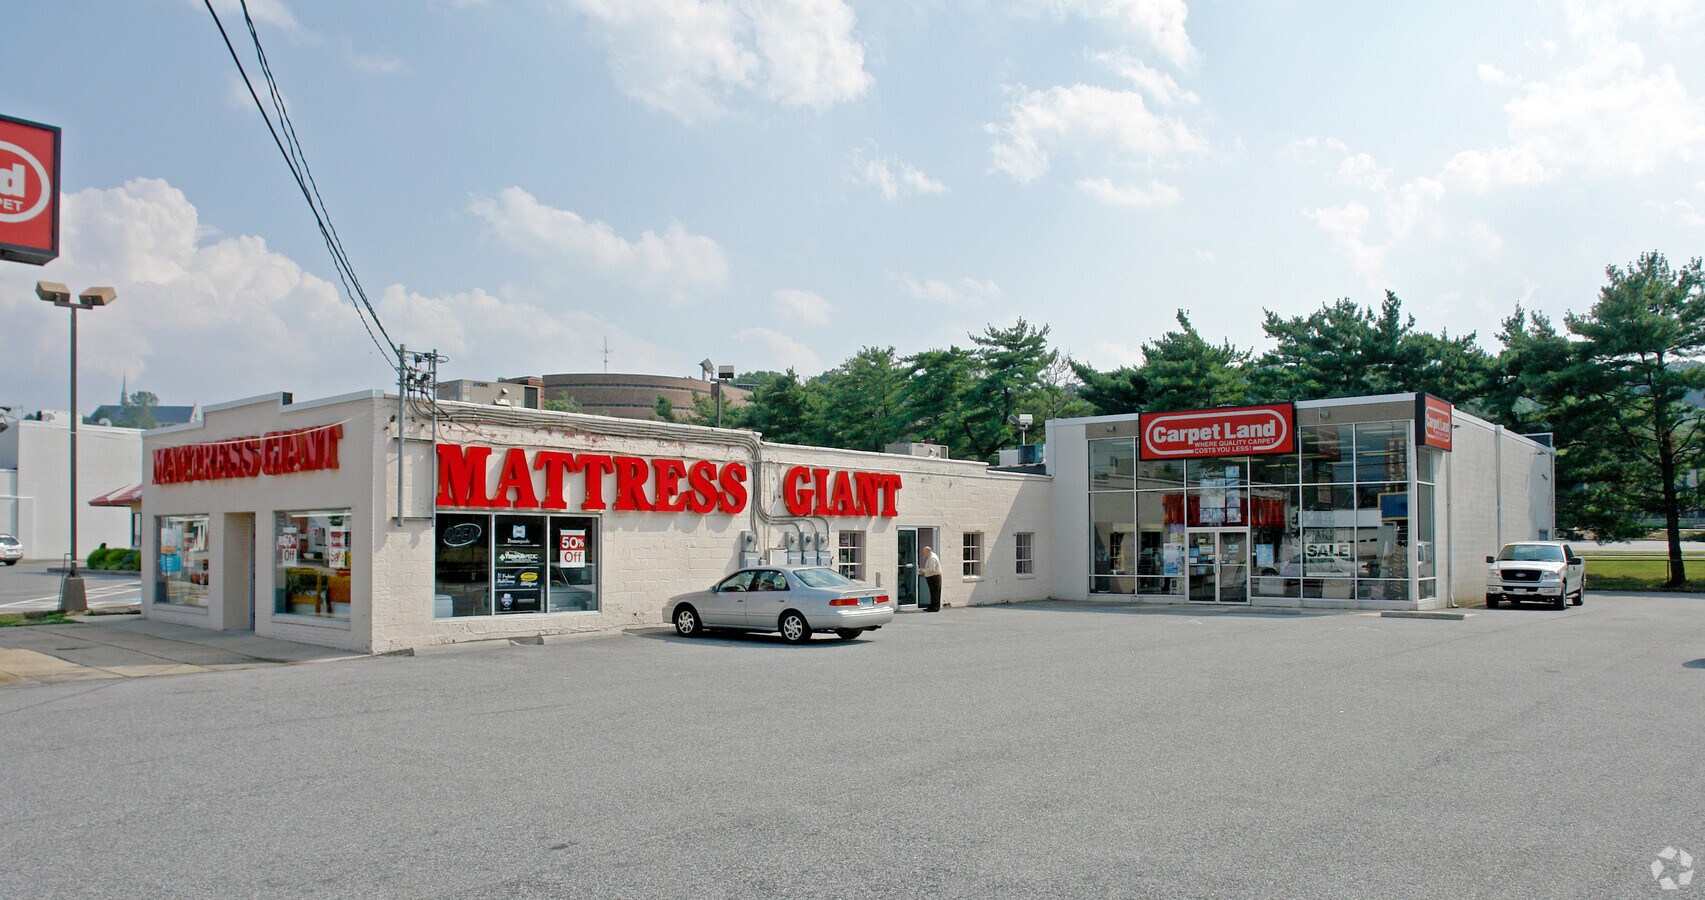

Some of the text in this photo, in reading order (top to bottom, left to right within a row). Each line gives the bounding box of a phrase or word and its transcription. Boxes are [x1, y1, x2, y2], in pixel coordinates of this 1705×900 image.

[1152, 420, 1276, 445] Carpet Land
[1194, 437, 1275, 448] WHERE QUALITY CARPET
[152, 423, 343, 485] MATTRESS GIANT
[436, 443, 902, 517] MATTRESS GIANT
[561, 536, 584, 549] 50%
[564, 551, 582, 563] Off
[1306, 544, 1349, 558] SALE
